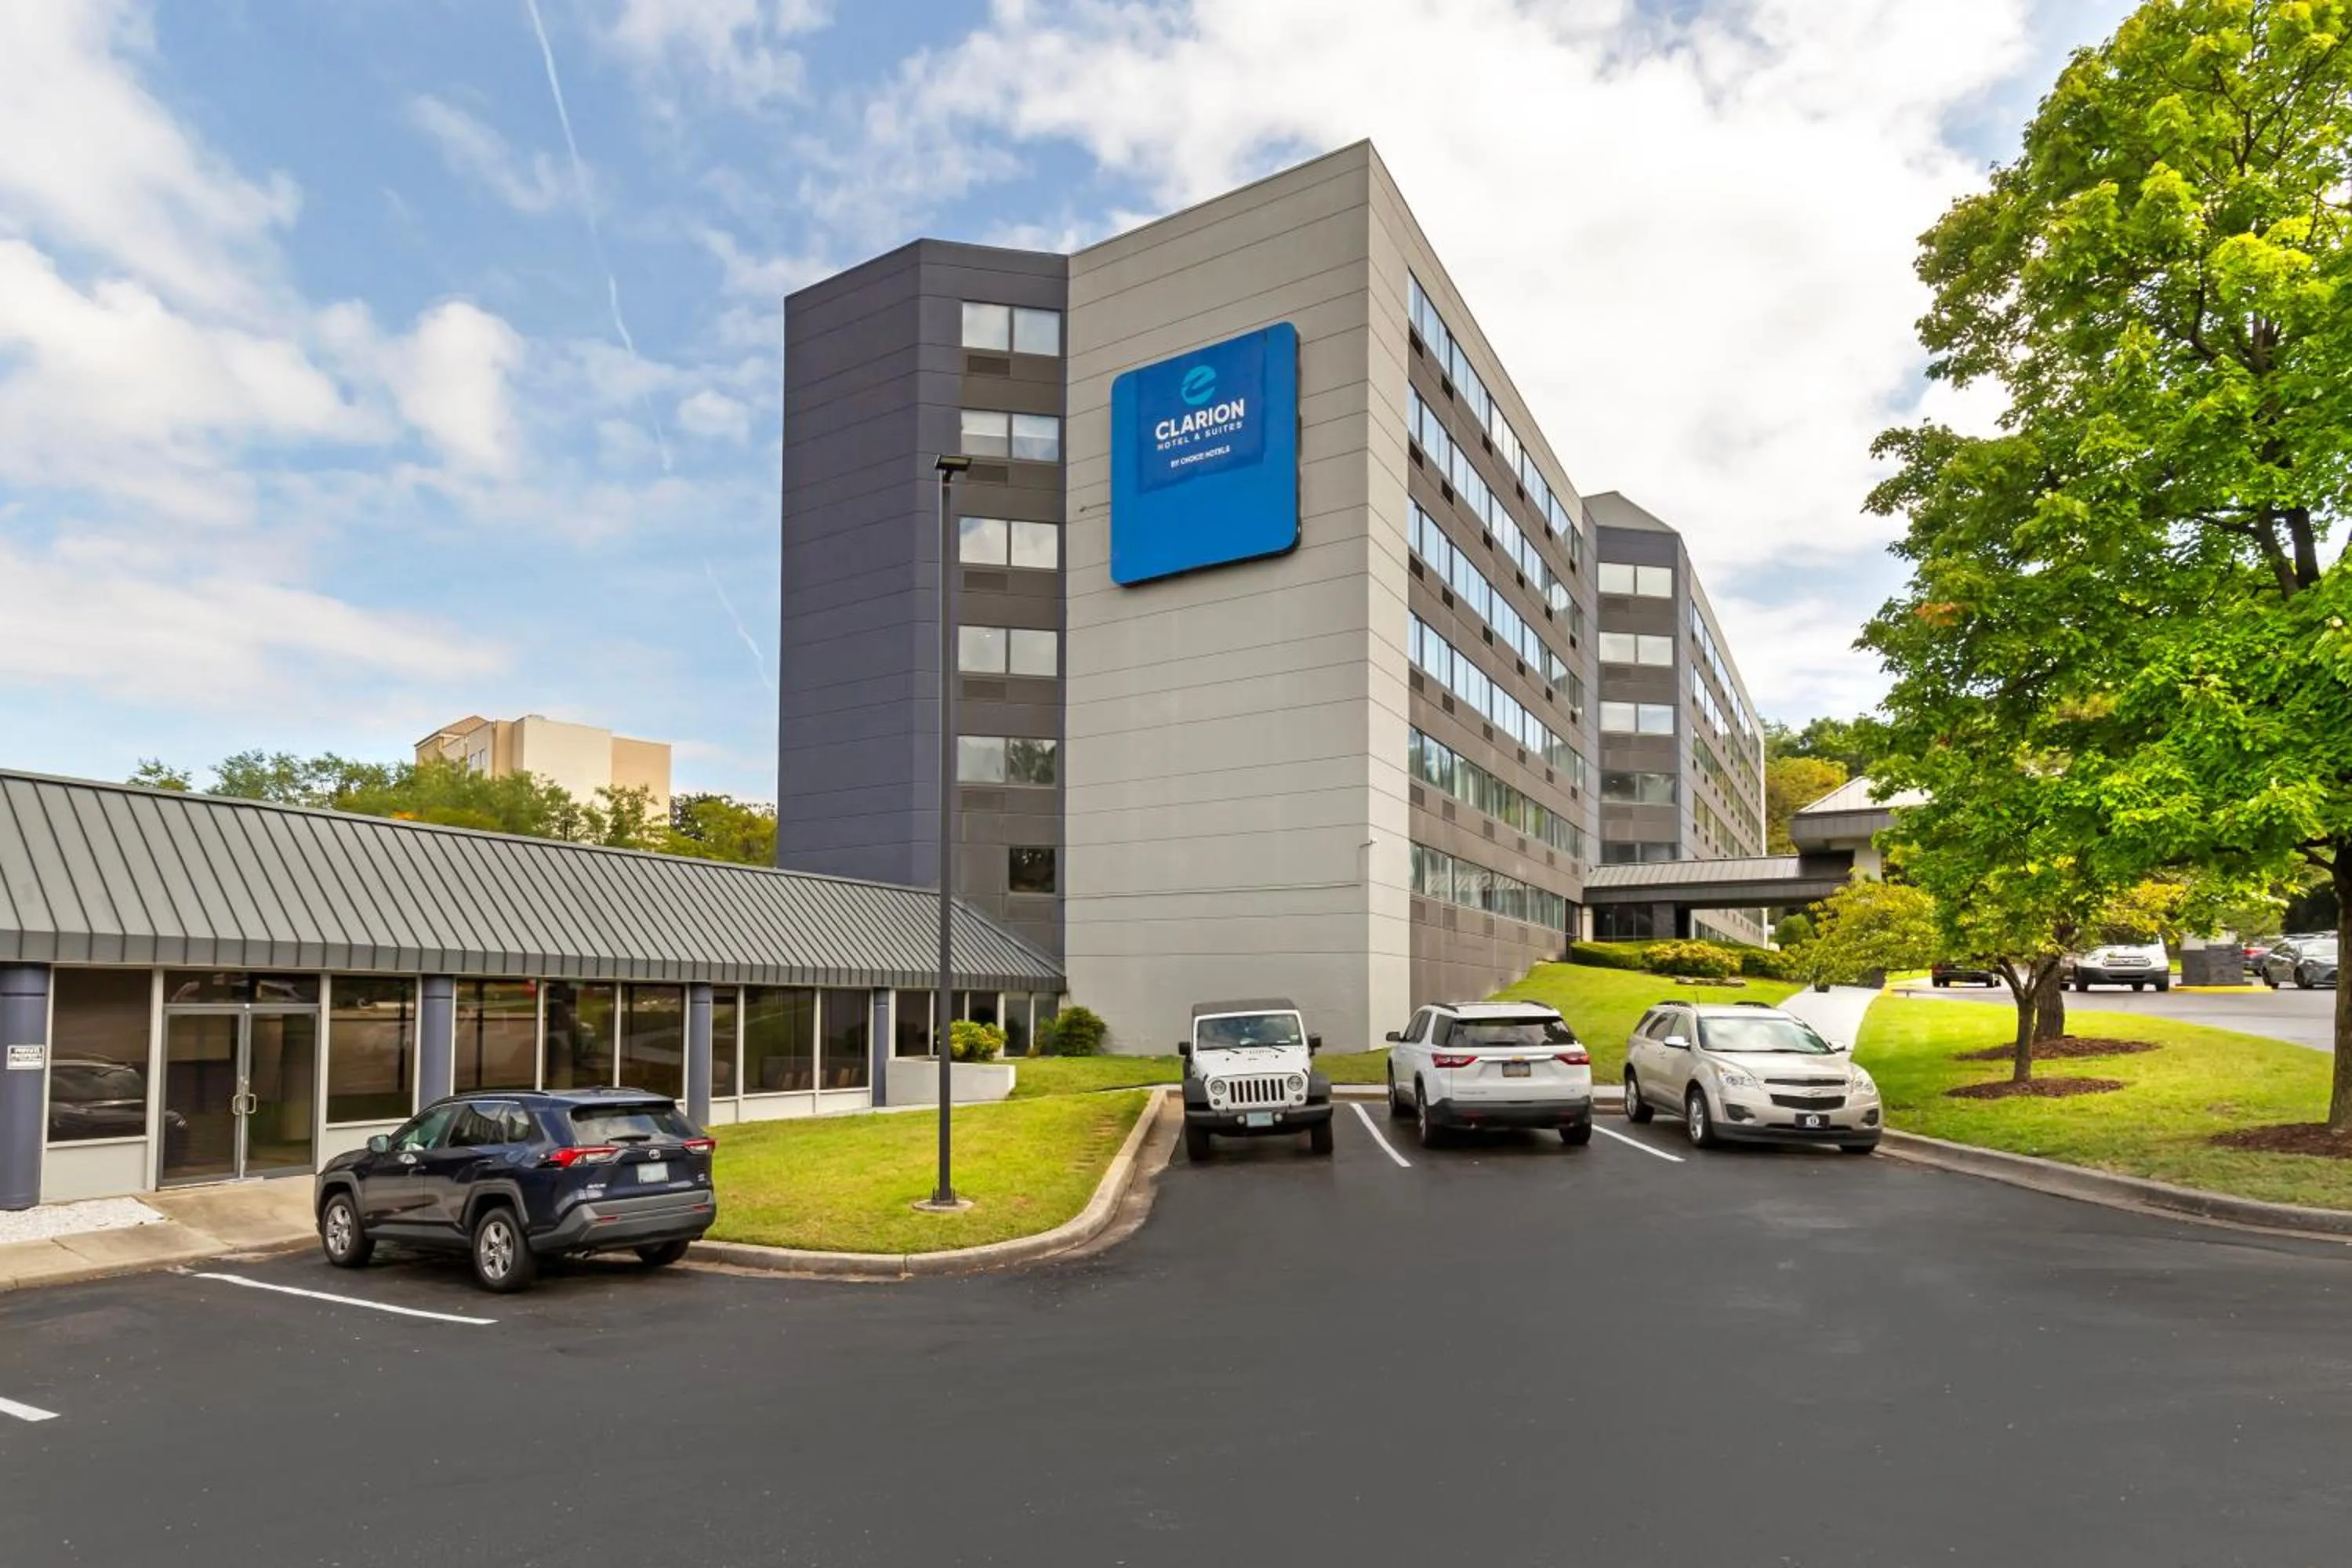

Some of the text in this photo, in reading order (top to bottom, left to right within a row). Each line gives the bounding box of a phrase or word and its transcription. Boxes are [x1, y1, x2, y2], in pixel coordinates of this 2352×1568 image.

[1156, 398, 1244, 440] CLARION
[1157, 437, 1189, 451] HOTEL
[1205, 421, 1243, 438] SUITES
[1181, 452, 1204, 465] CHOICE
[1205, 445, 1230, 457] HOTELS
